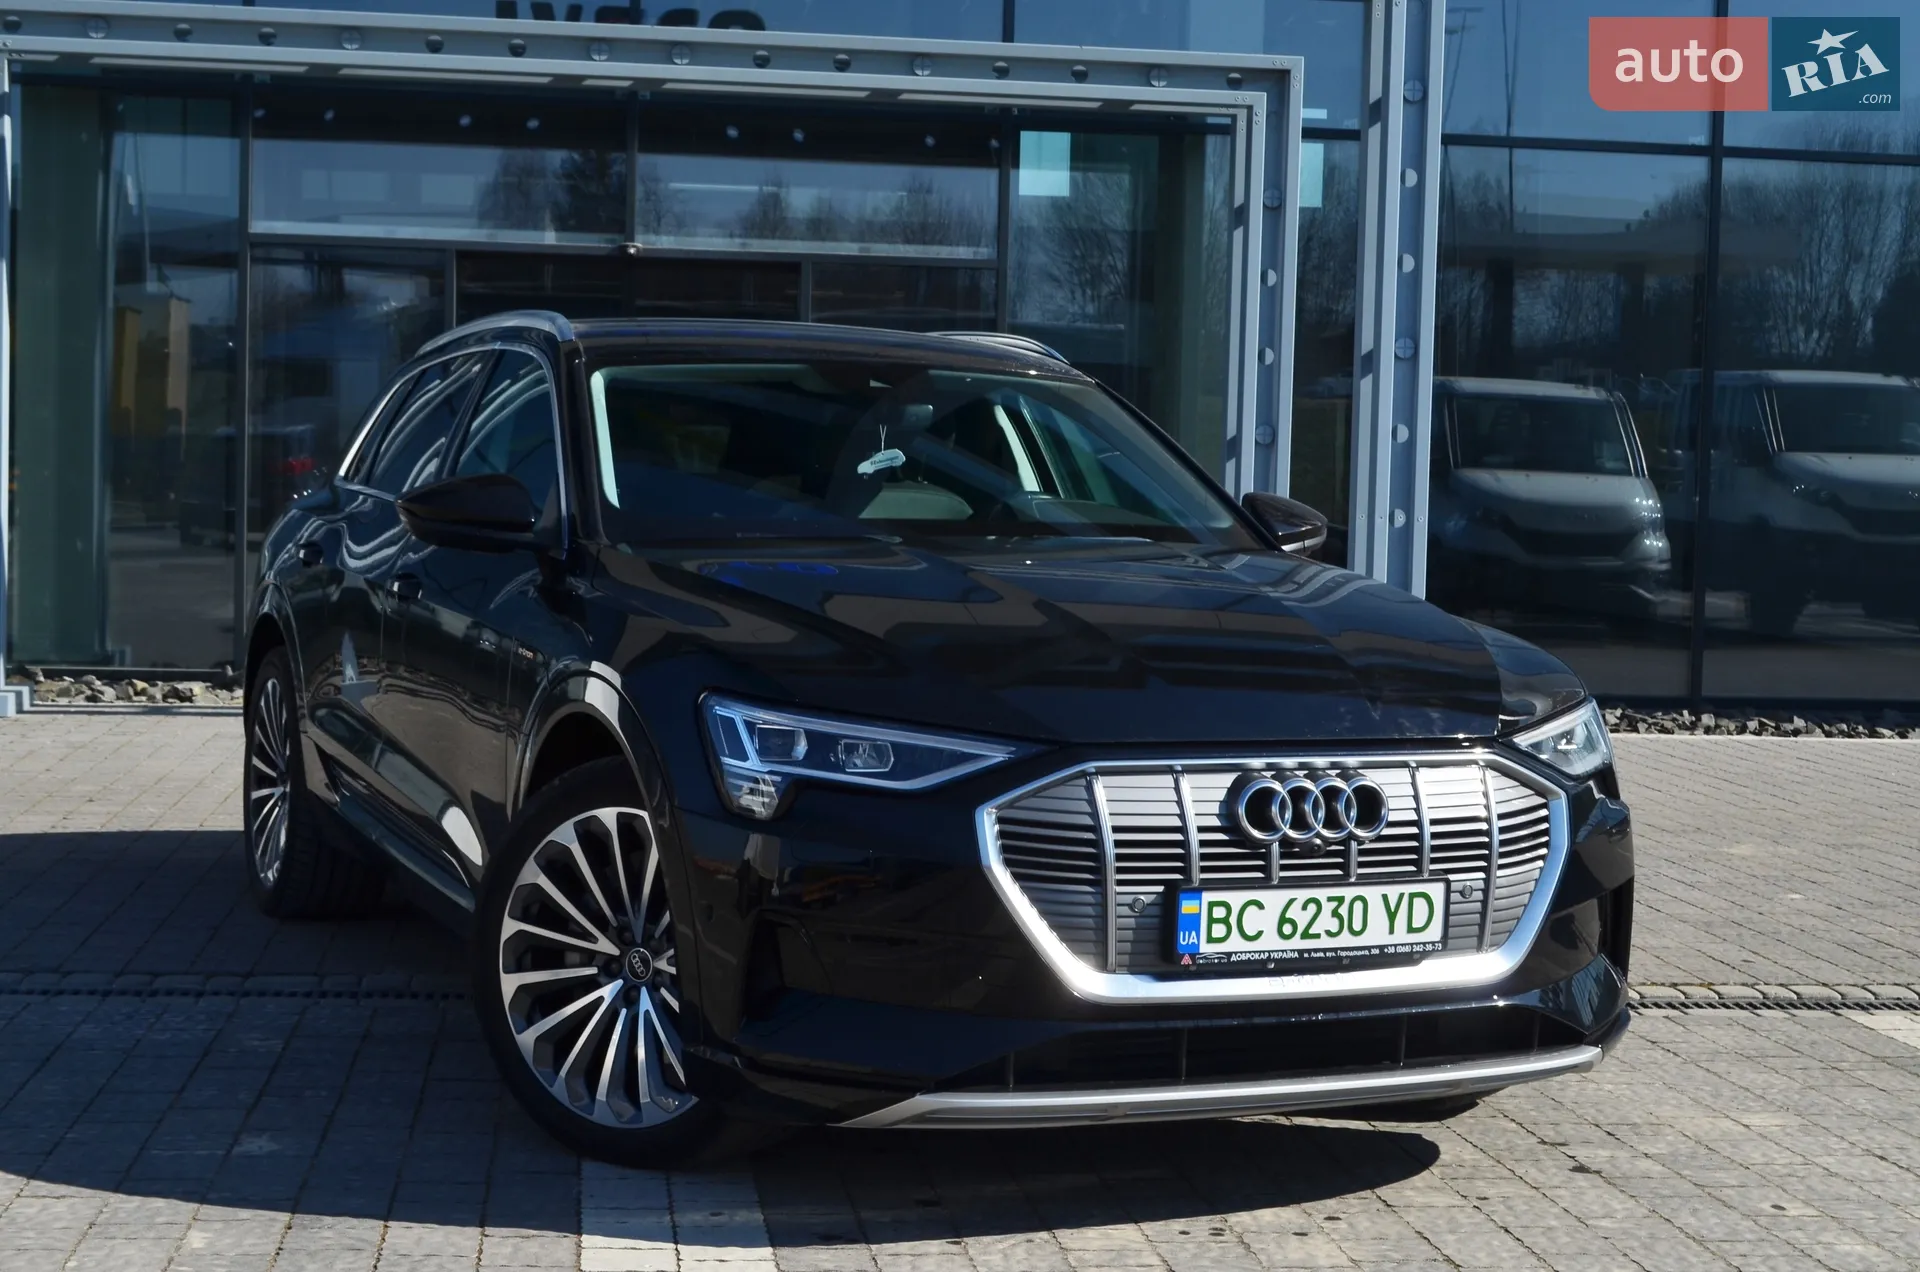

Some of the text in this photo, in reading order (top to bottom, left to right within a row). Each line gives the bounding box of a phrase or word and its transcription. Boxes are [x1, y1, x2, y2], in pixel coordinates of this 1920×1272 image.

[1206, 891, 1435, 945] BC 6230 YD
[1179, 930, 1198, 945] UA
[1230, 951, 1269, 962] ДОБРОКАР
[1270, 950, 1299, 959] УКРАЇНА
